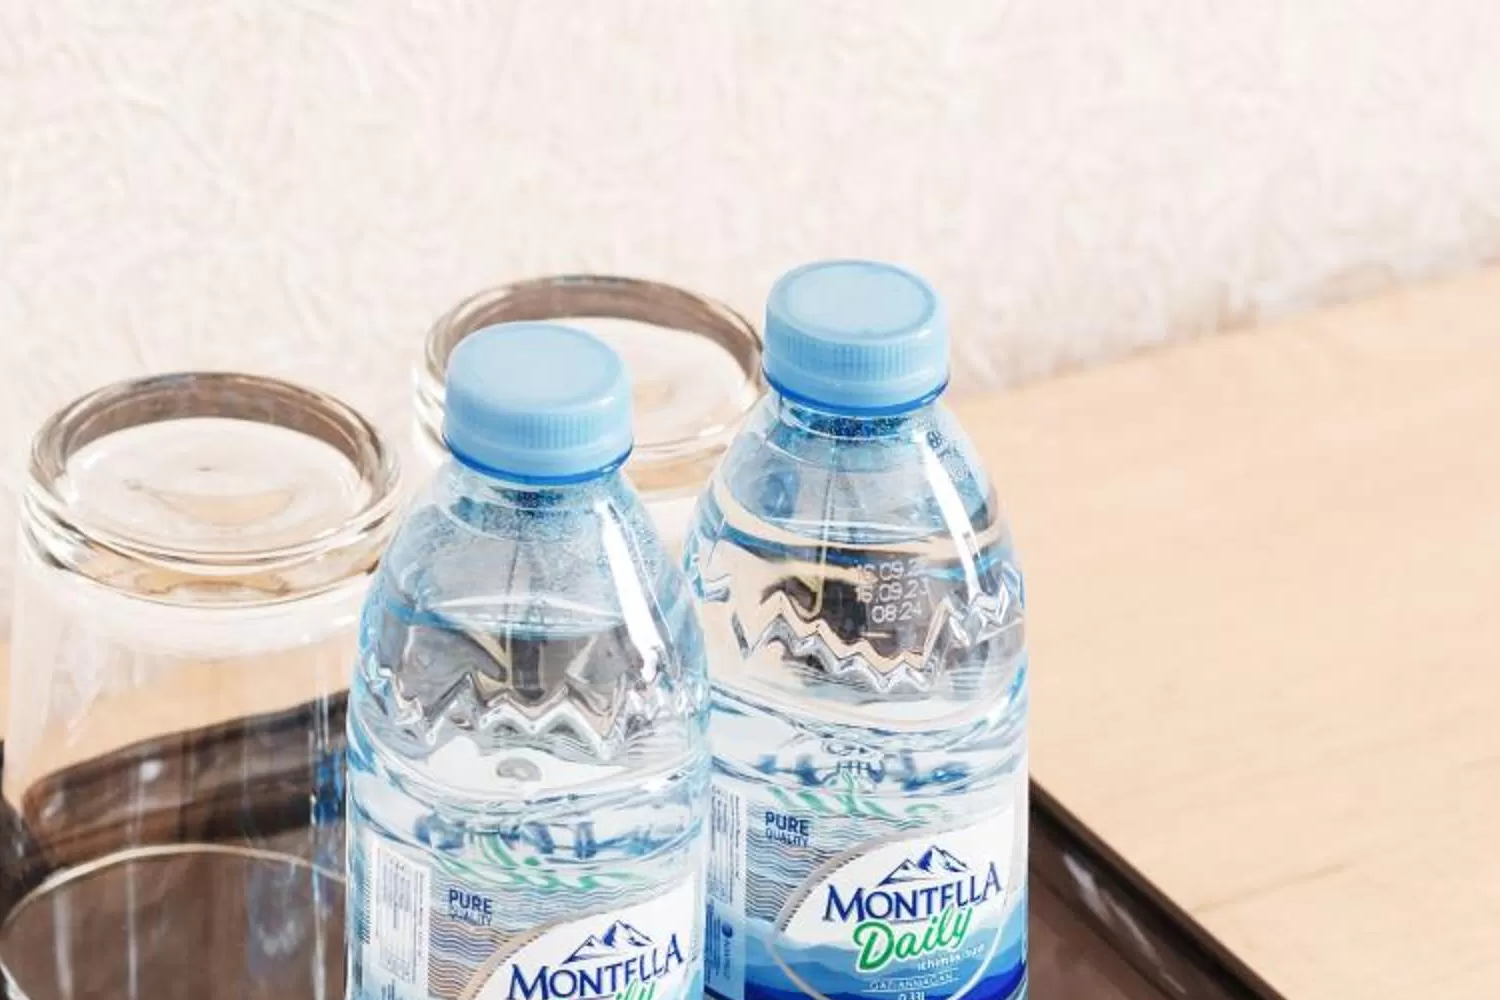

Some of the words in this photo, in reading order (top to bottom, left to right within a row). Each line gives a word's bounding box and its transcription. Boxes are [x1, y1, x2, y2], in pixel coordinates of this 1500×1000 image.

[765, 811, 810, 837] PURE
[449, 888, 493, 915] PURE
[822, 861, 1004, 923] MONTELLA
[853, 904, 972, 971] Daily
